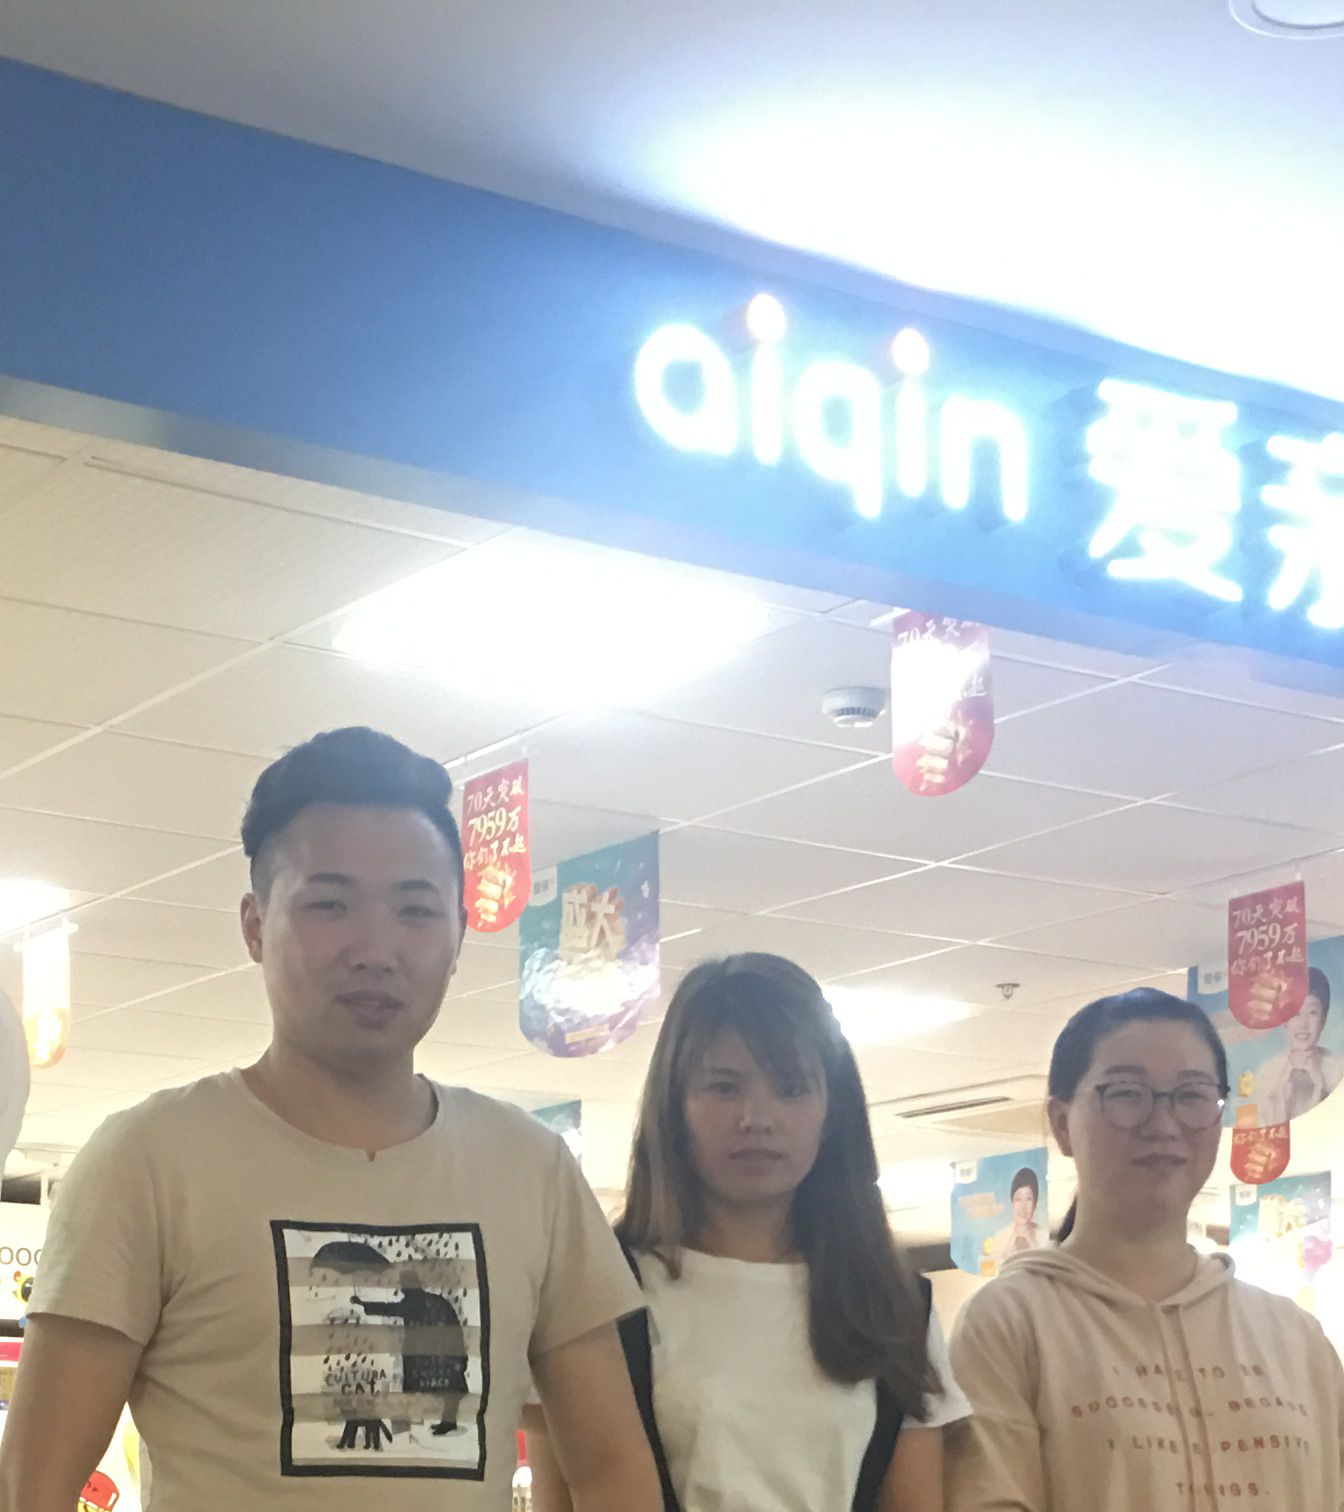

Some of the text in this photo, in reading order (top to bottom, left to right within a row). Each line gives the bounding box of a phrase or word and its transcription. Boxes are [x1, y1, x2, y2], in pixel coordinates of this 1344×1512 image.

[630, 292, 1030, 522] aiqin
[467, 805, 522, 847] 7959万
[462, 832, 527, 872] 你们了不起
[1232, 895, 1301, 929] 70天突破
[1236, 922, 1299, 955] 7959万
[1230, 948, 1305, 977] 你们了不起
